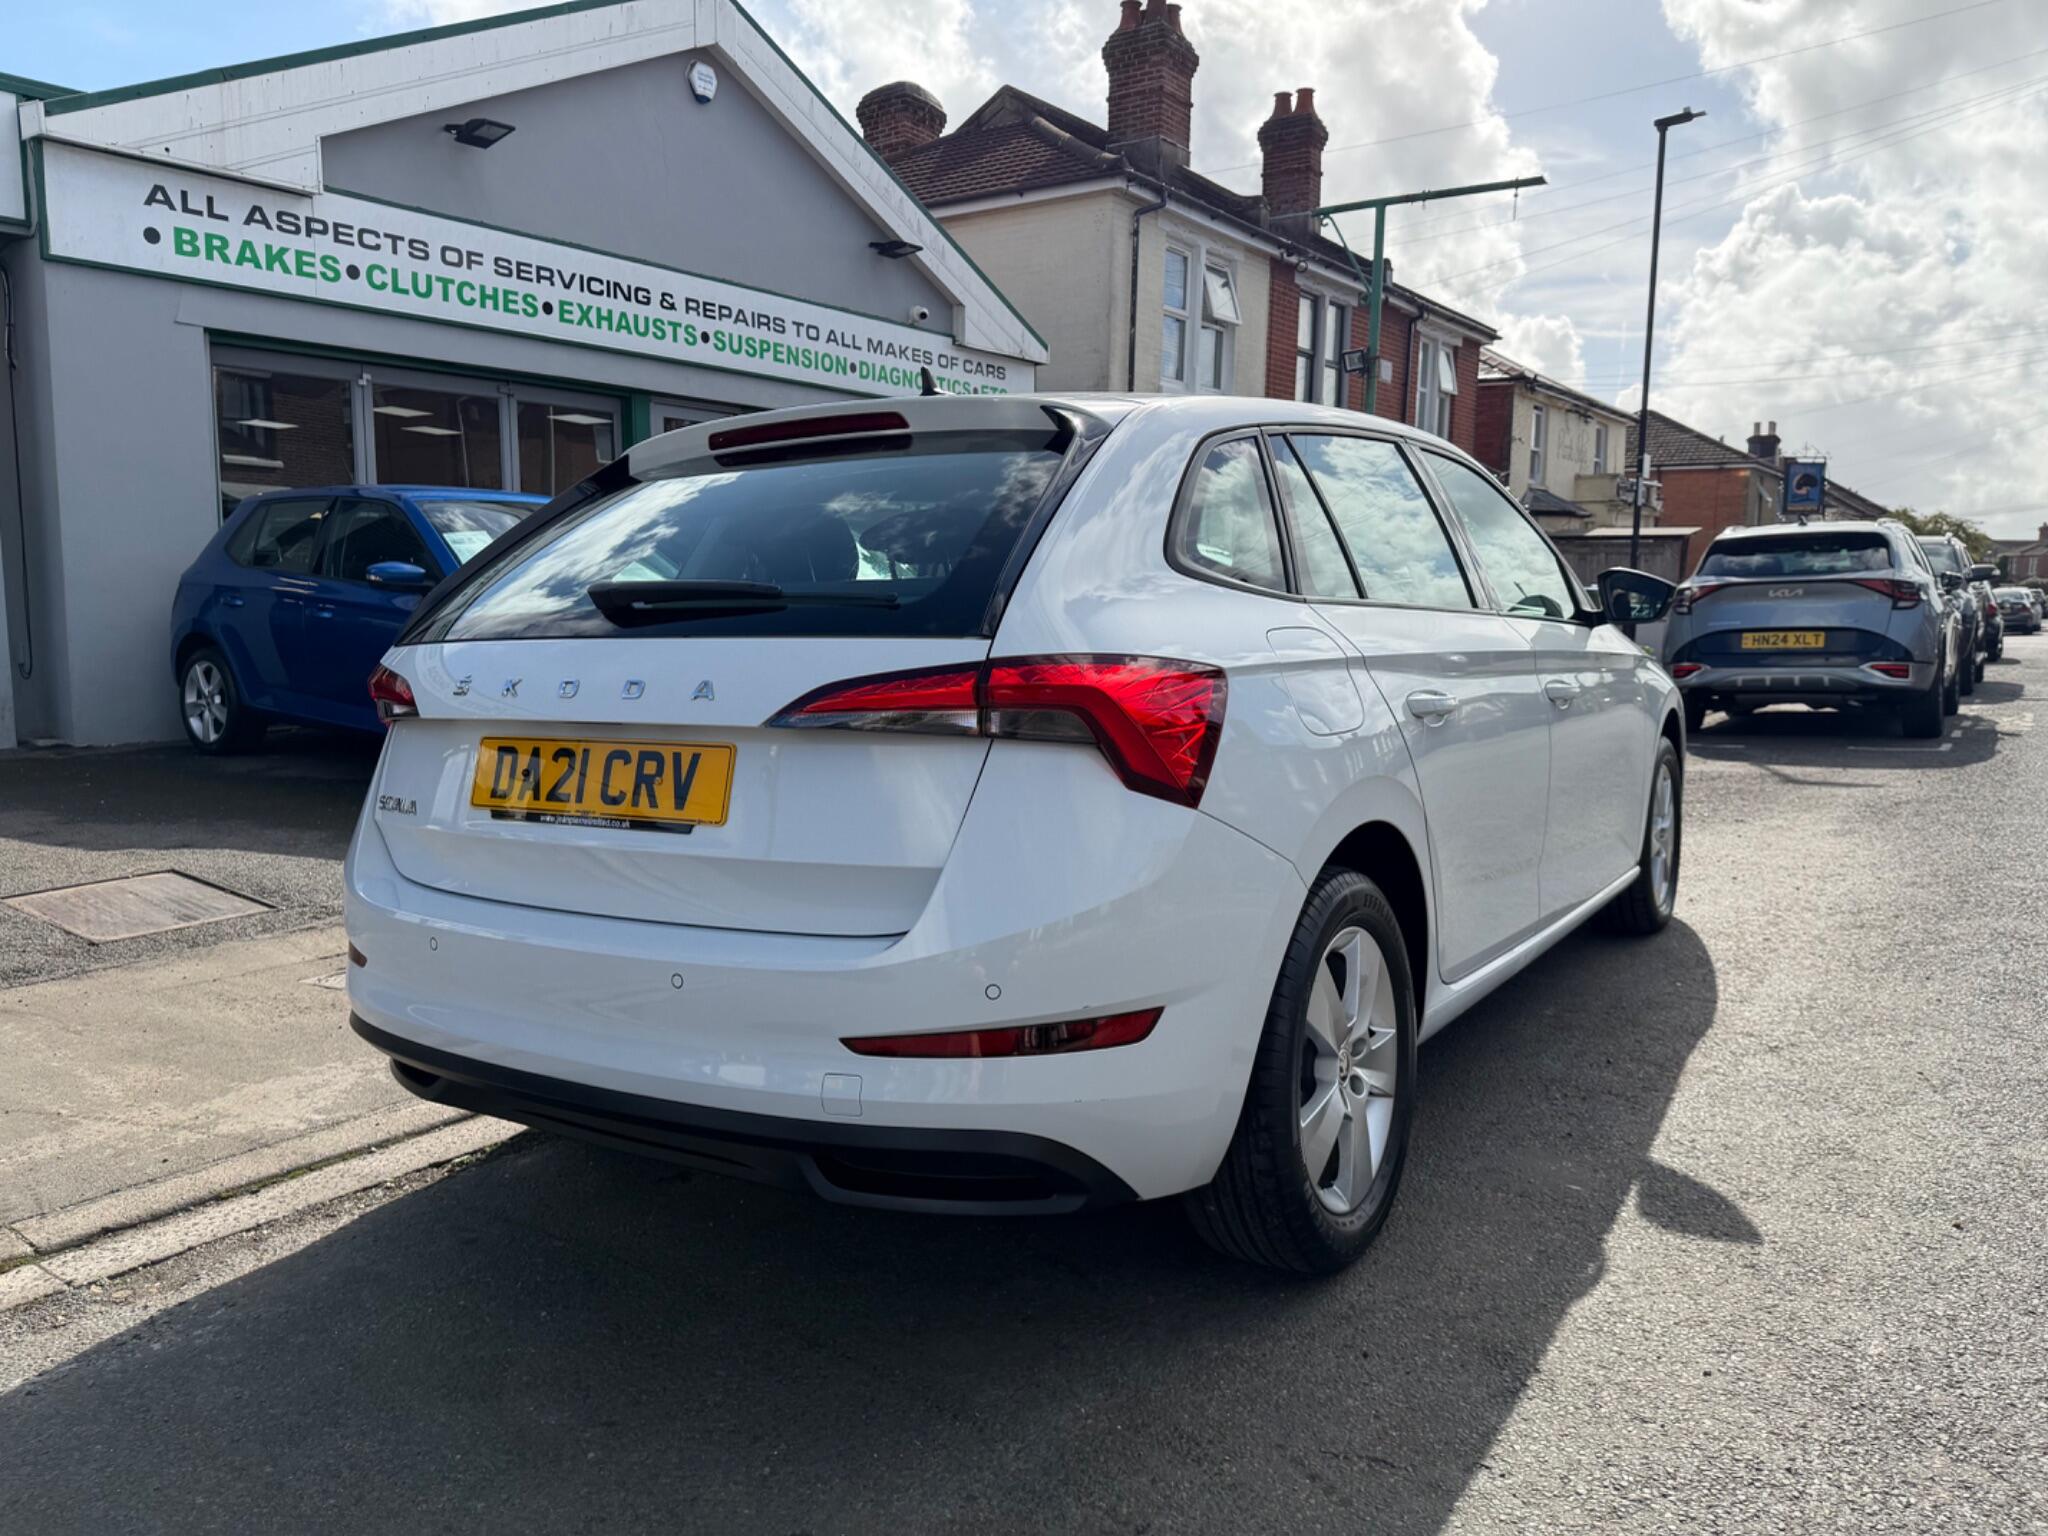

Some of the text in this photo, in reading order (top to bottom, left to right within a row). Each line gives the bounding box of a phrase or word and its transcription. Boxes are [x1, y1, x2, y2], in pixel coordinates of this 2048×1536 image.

[143, 184, 1006, 380] ALL ASPECTS OF SERVICING & REPAIRS TO ALL MAKES OF CARS
[173, 226, 341, 283] BRAKES
[365, 263, 539, 318] CLUTCHES
[558, 300, 698, 346] EXHAUSTS
[713, 330, 848, 376] SUSPENSION
[858, 360, 971, 394] DIAGNOTICS
[1751, 633, 1822, 646] HN24 XLT
[490, 746, 702, 811] DA21 CRV
